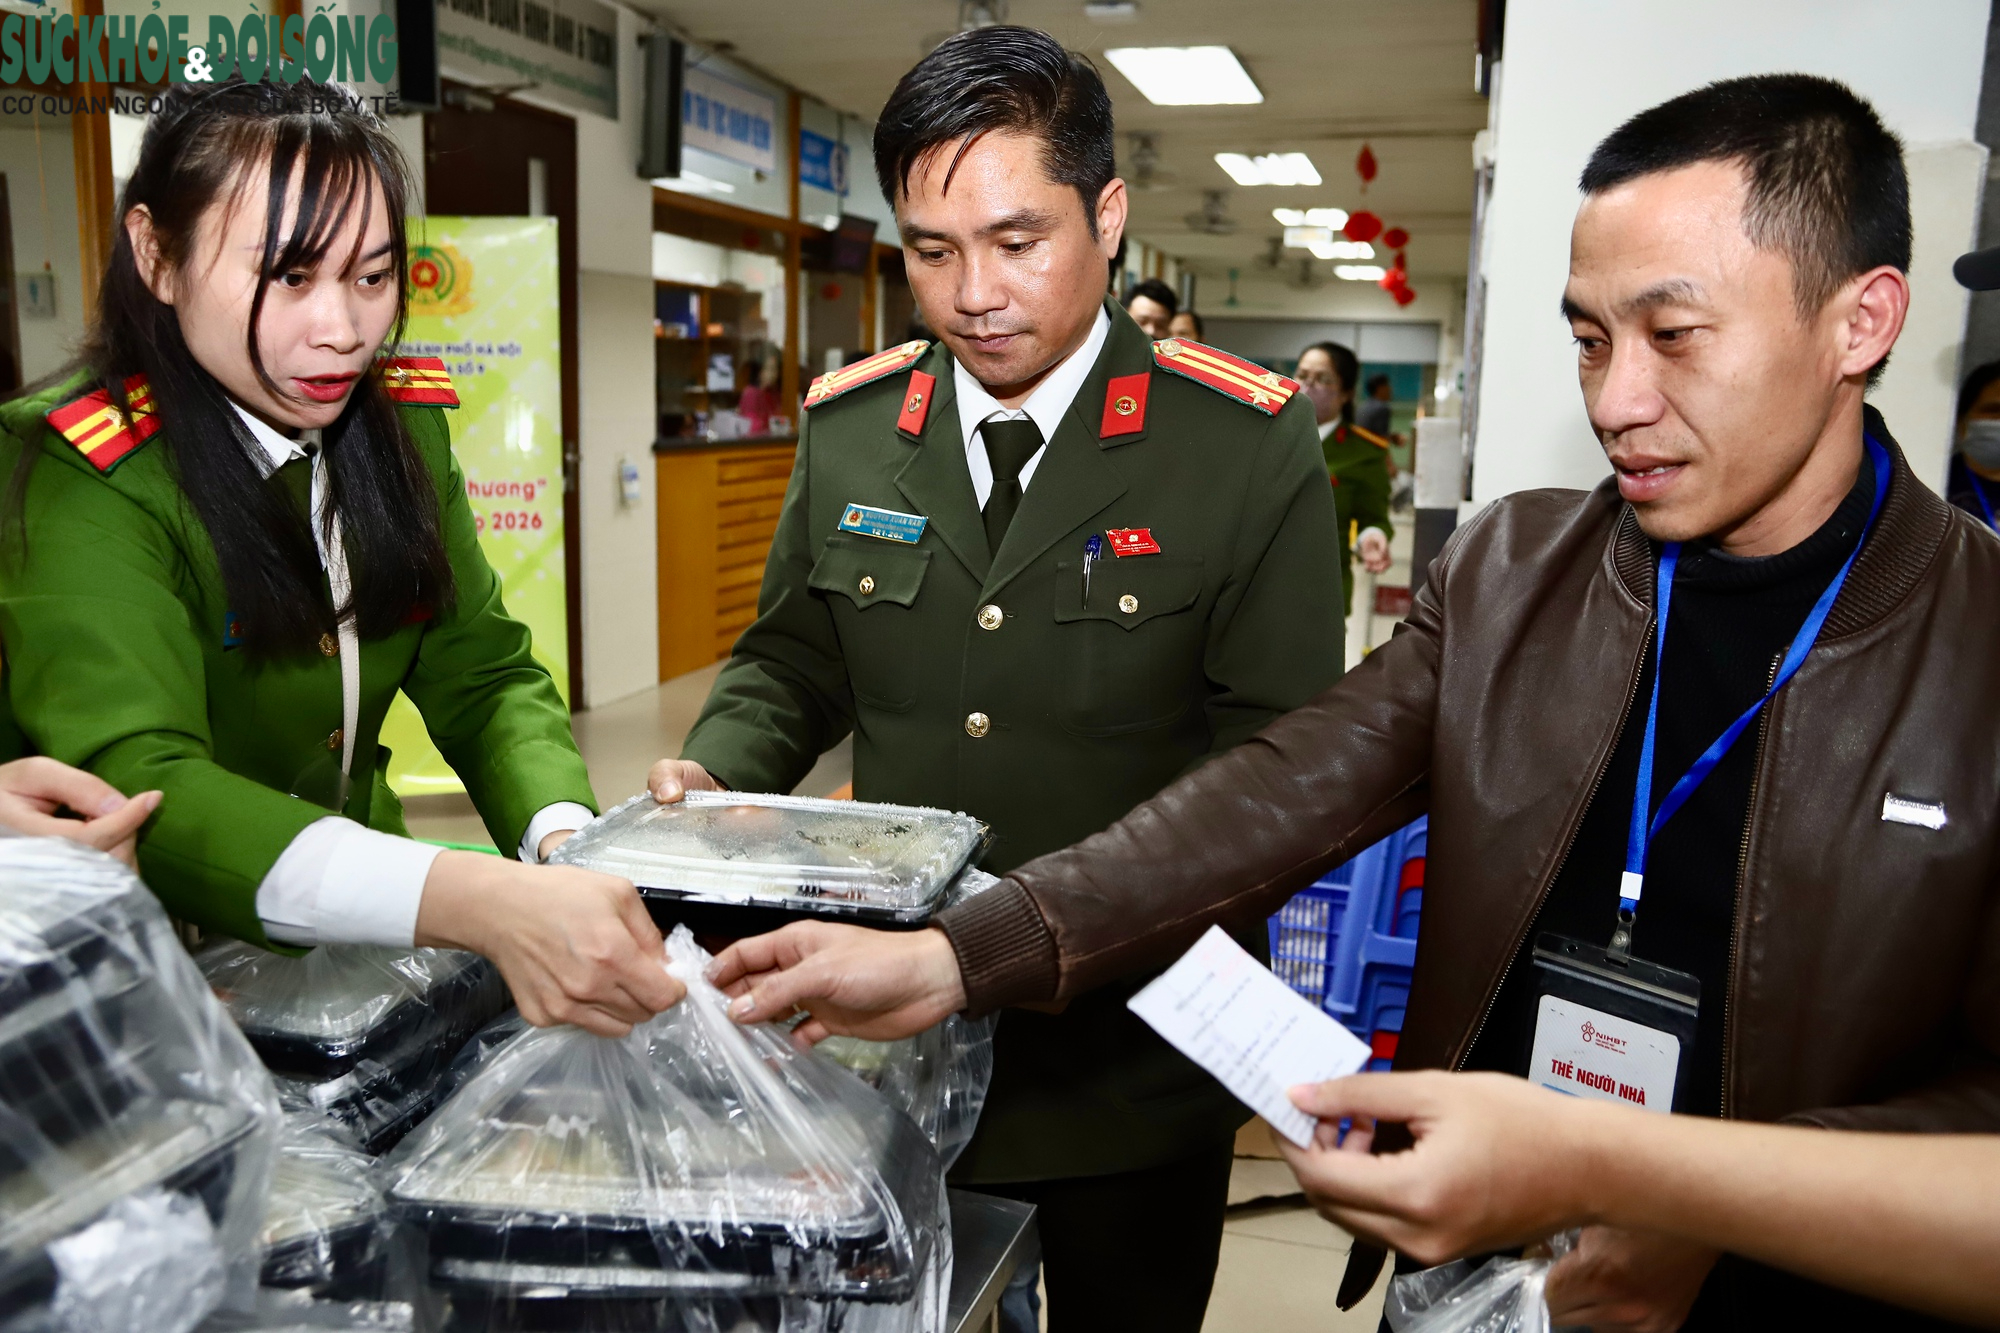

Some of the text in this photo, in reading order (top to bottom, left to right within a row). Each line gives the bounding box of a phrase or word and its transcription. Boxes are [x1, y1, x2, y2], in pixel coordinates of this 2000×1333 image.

[445, 341, 473, 355] PHỐ
[475, 342, 493, 355] HÀ
[497, 342, 521, 357] NỘI
[492, 511, 542, 531] 2026
[1595, 1031, 1627, 1047] NIHBT
[1551, 1059, 1646, 1106] THẺ NGƯỜI NHÀ
